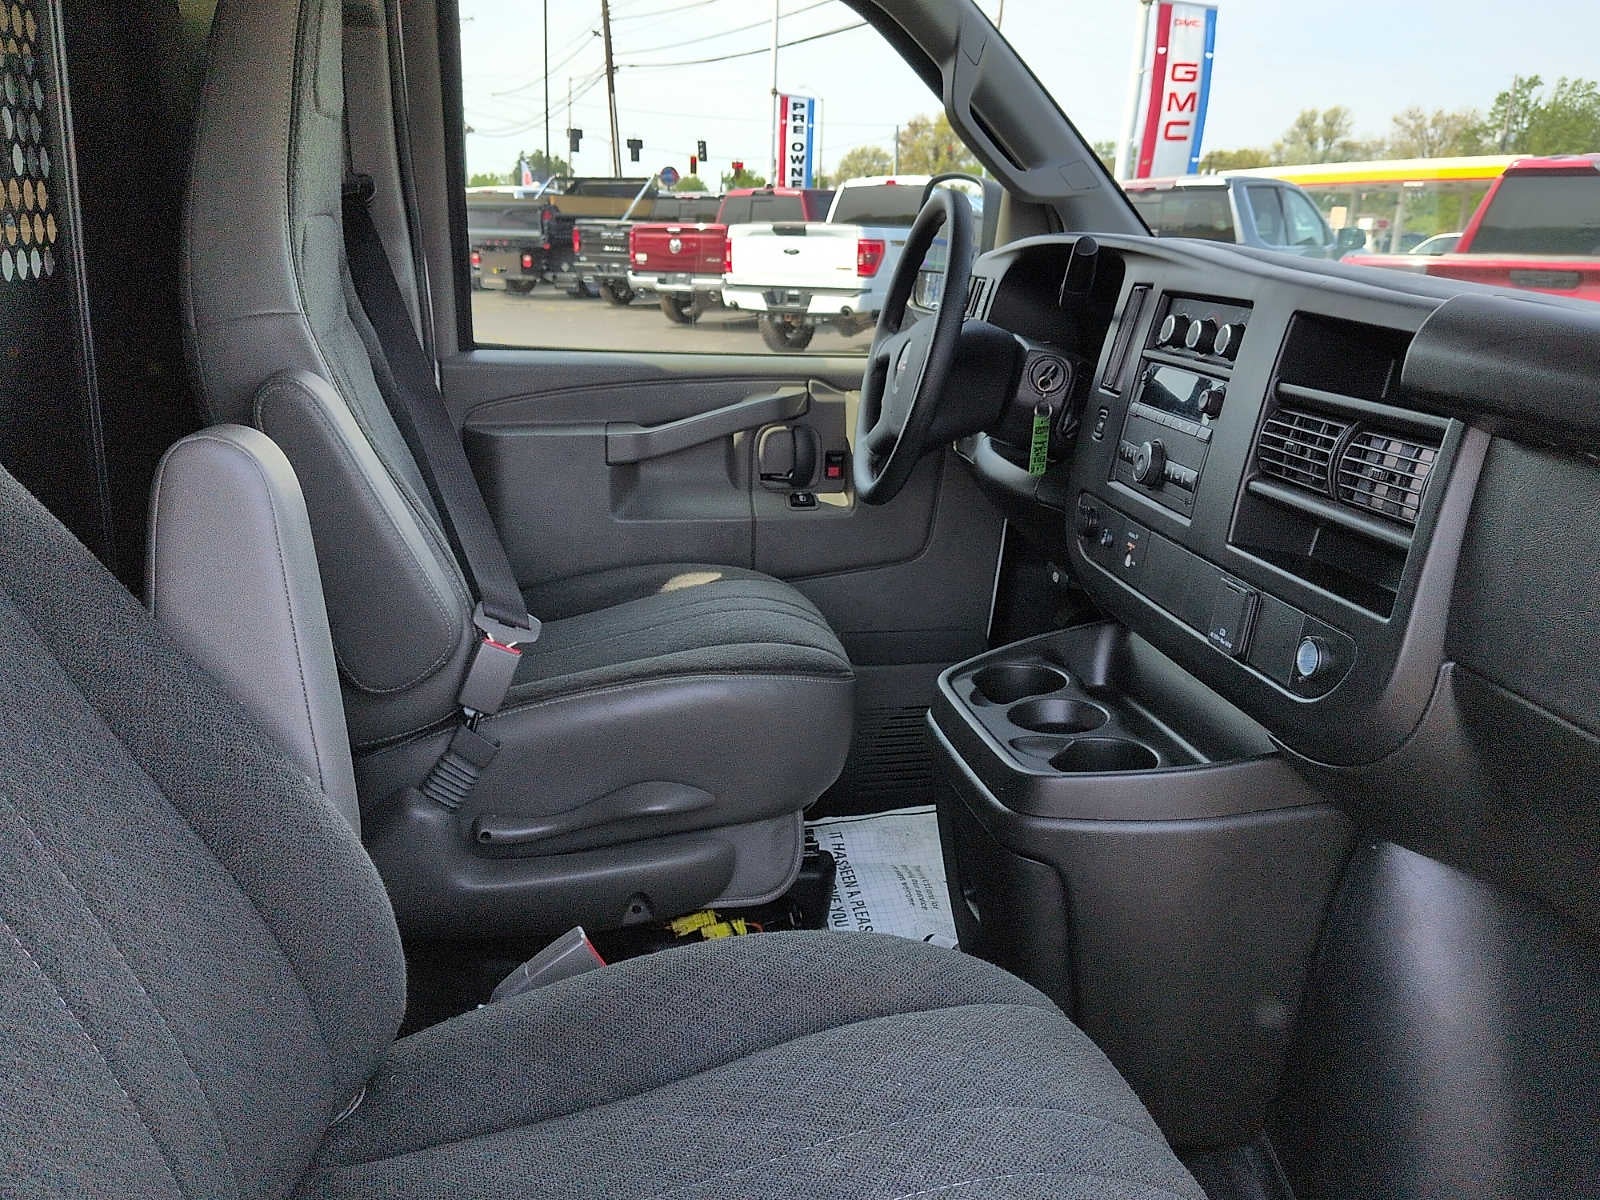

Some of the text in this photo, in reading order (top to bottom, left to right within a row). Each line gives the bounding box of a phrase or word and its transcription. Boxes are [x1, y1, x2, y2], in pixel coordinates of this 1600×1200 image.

[1164, 63, 1198, 141] GMC
[790, 102, 805, 188] PRE OWNE
[829, 832, 844, 840] IT
[831, 843, 849, 866] HAS
[846, 890, 862, 899] A
[831, 906, 850, 928] YOU
[850, 901, 874, 933] PLEAS
